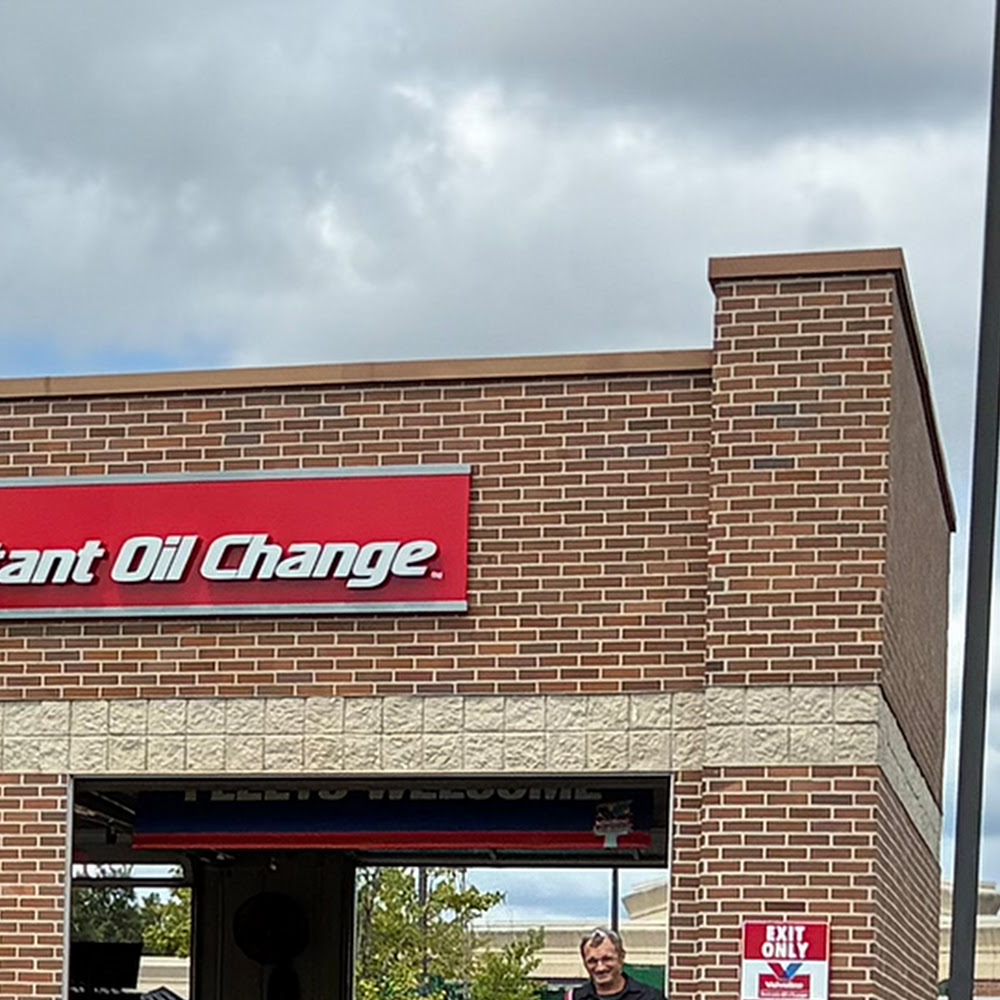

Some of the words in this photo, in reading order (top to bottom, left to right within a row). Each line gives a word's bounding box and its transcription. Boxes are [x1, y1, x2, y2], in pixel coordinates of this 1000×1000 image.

[110, 534, 199, 584] Oil
[200, 533, 438, 589] Change
[766, 925, 805, 941] EXIT
[761, 942, 809, 959] ONLY
